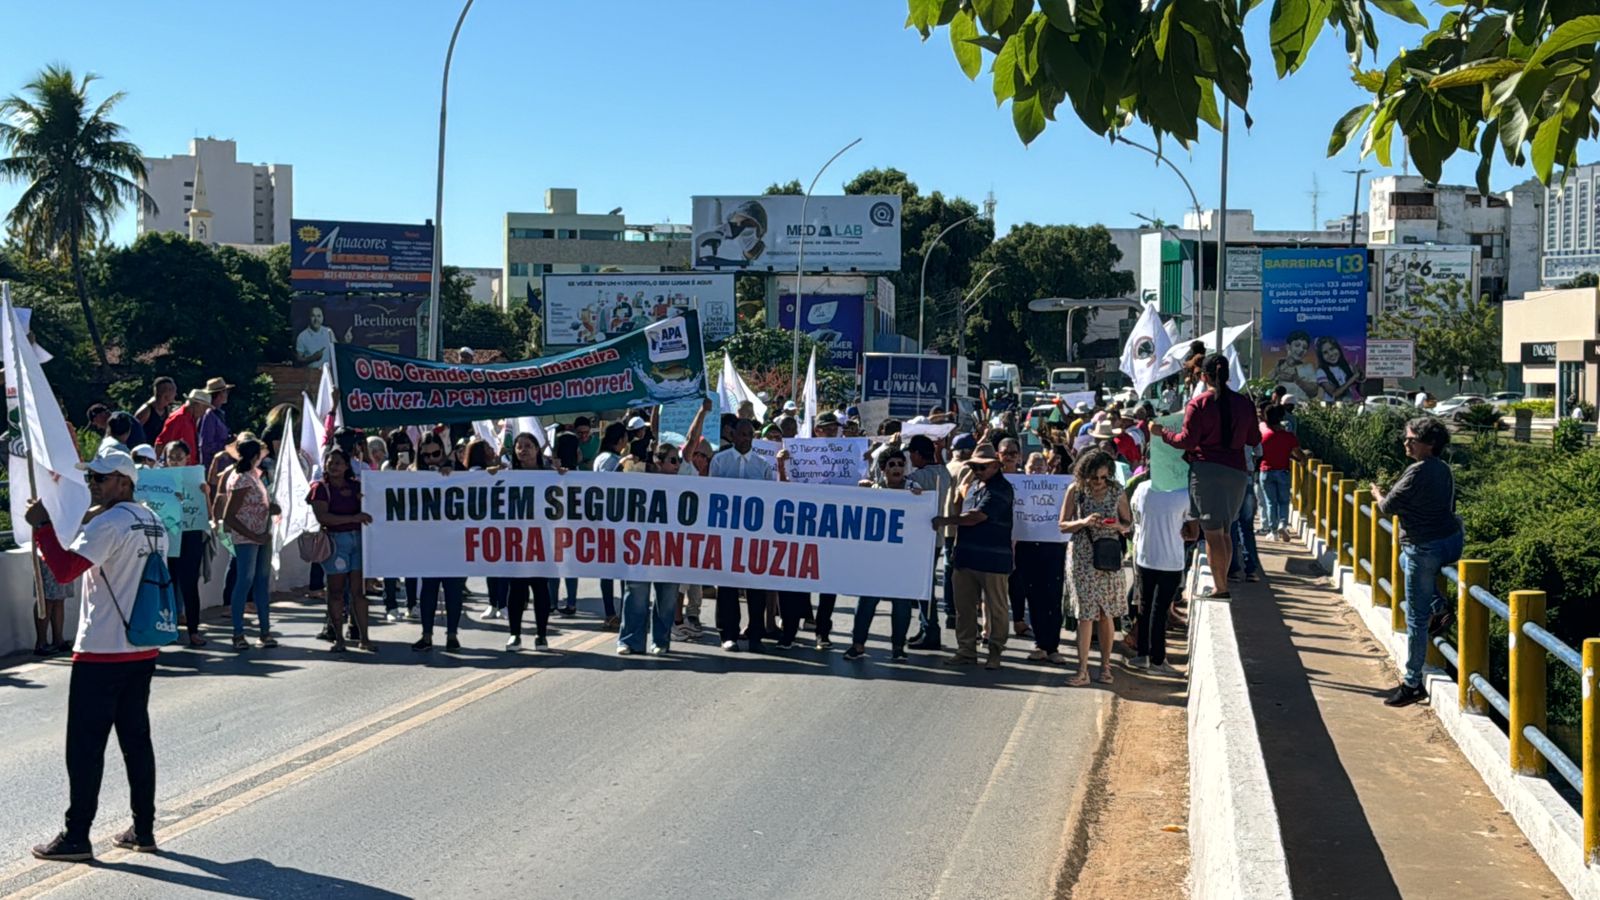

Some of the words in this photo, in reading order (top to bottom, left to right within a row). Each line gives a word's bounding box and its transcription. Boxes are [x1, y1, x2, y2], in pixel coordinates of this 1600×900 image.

[786, 225, 816, 236] MED
[835, 225, 863, 236] LAB
[1264, 258, 1334, 269] BARREIRAS
[1336, 254, 1364, 273] 133
[1420, 261, 1432, 276] 6
[1272, 297, 1313, 305] crescendo
[1315, 297, 1336, 305] junto
[354, 313, 417, 327] Beethoven
[661, 326, 682, 340] APA
[355, 358, 372, 380] O
[372, 358, 403, 382] Rio
[404, 363, 470, 383] Grande
[486, 366, 541, 383] nossa
[543, 348, 620, 377] maneira
[348, 388, 373, 412] de
[373, 387, 426, 410] viver.
[427, 389, 444, 409] A
[489, 387, 526, 405] tem
[528, 382, 562, 405] que
[565, 368, 634, 399] morrer!
[873, 380, 938, 394] LUMINA
[385, 480, 535, 521] NINGUÉM
[544, 486, 668, 524] SEGURA
[677, 491, 699, 526] O
[707, 493, 764, 532] RIO
[773, 499, 905, 544] GRANDE
[465, 527, 545, 563] FORA
[554, 527, 616, 564] PCH
[623, 528, 722, 571] SANTA
[731, 536, 820, 580] LUZIA
